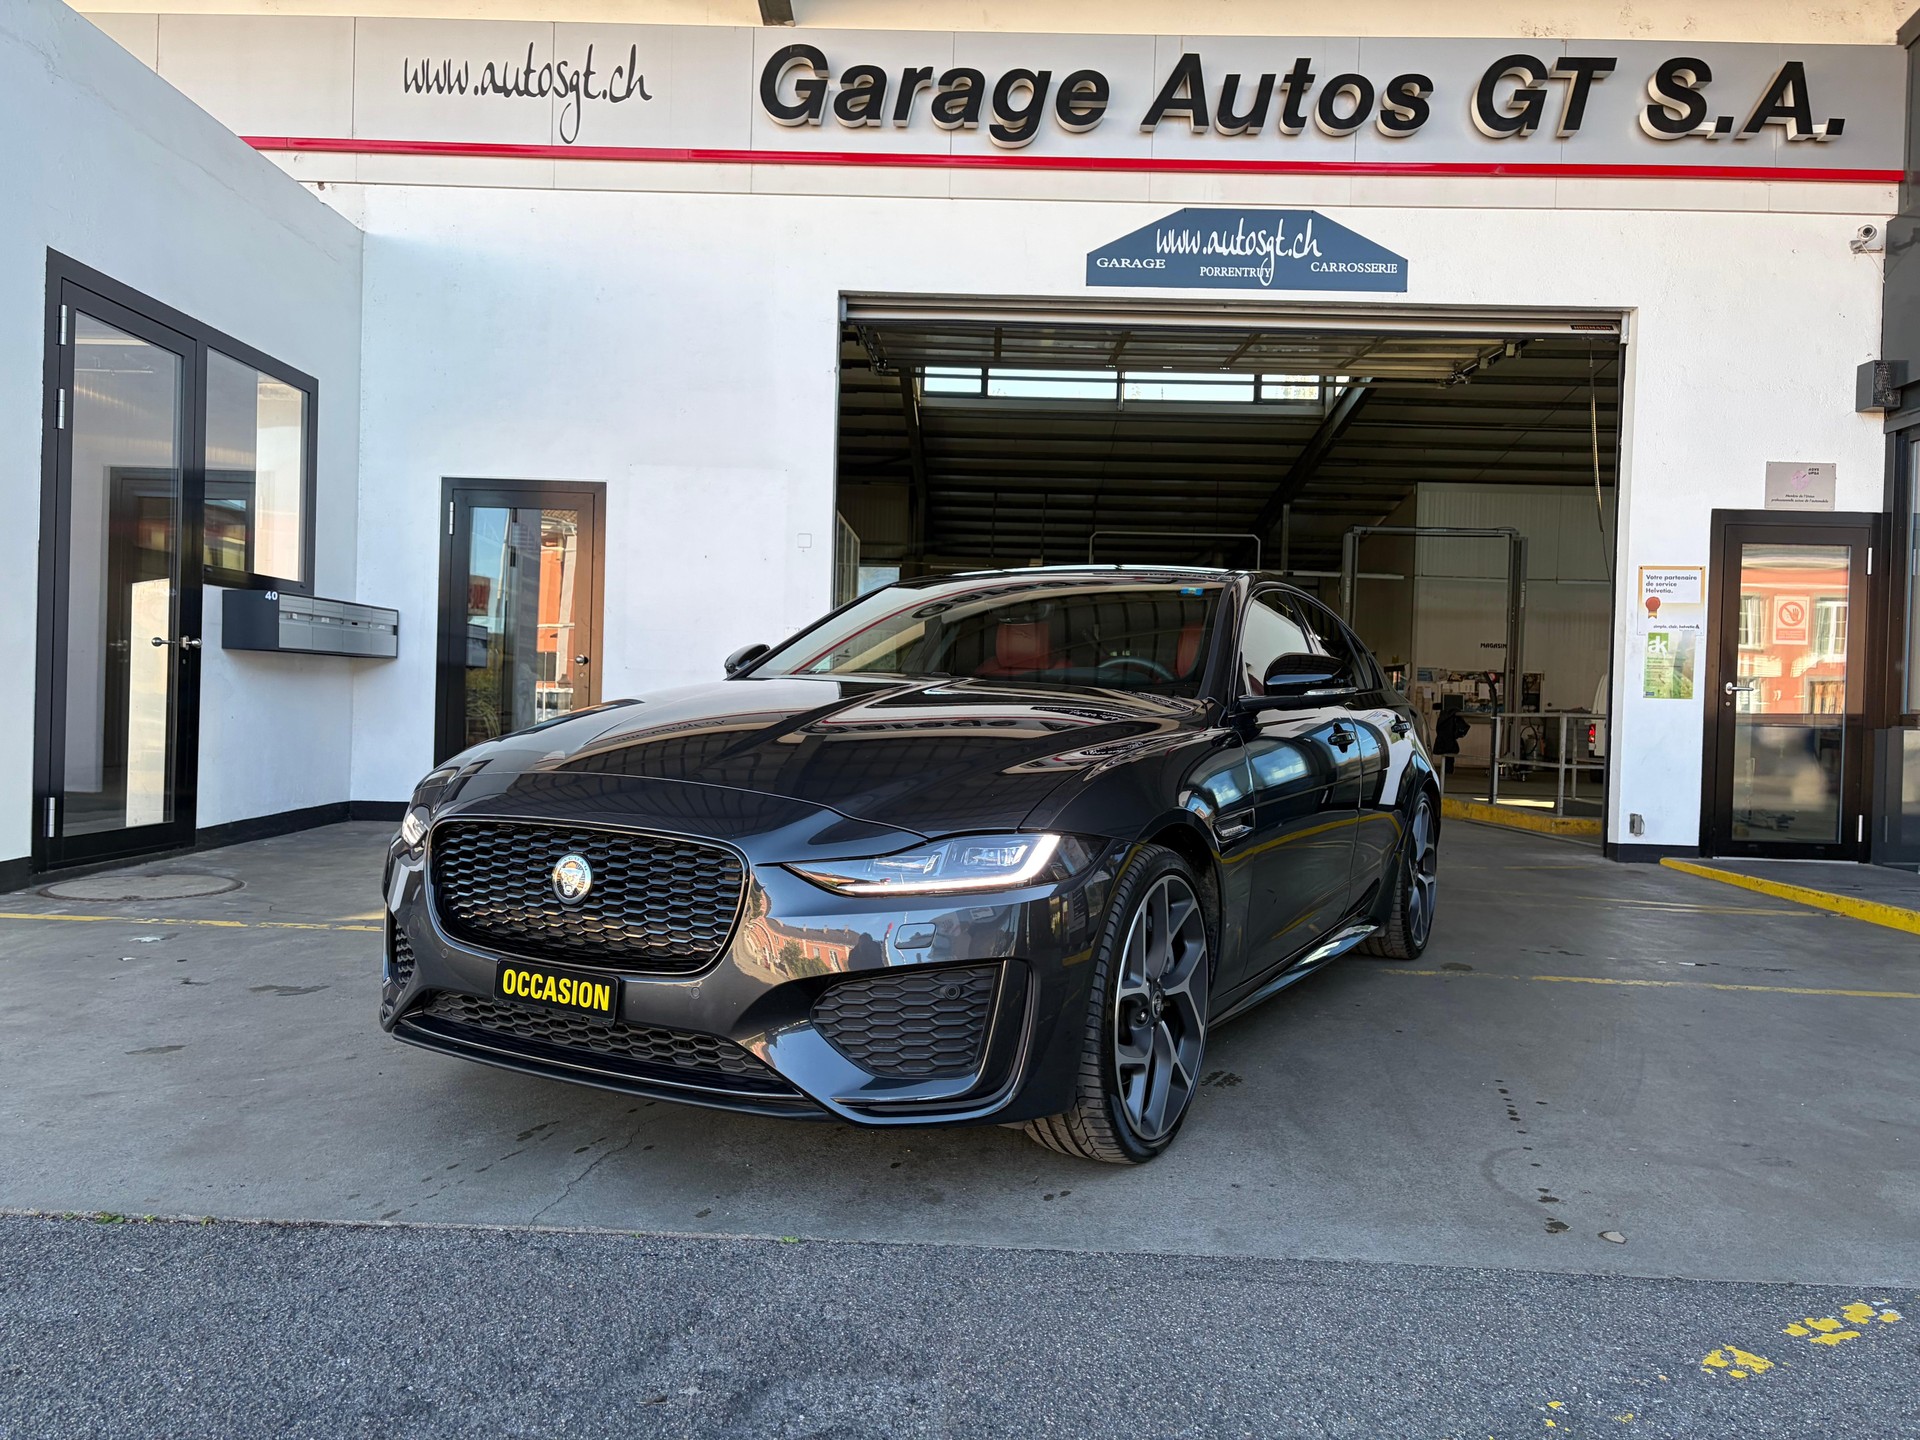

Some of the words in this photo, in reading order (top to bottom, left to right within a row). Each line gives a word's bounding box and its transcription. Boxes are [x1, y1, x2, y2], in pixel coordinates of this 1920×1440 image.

[404, 41, 653, 144] www.autosgt.ch
[759, 43, 1110, 149] Garage
[1139, 52, 1434, 138] Autos
[1470, 53, 1618, 139] GT
[1639, 56, 1846, 141] S.A.
[1096, 257, 1166, 269] GARAGE
[1156, 217, 1323, 287] www.autosgt.ch
[1199, 266, 1272, 278] PORRENTRUY
[1310, 261, 1398, 274] CARROSSERIE
[264, 591, 278, 601] 40
[502, 968, 610, 1011] OCCASION
